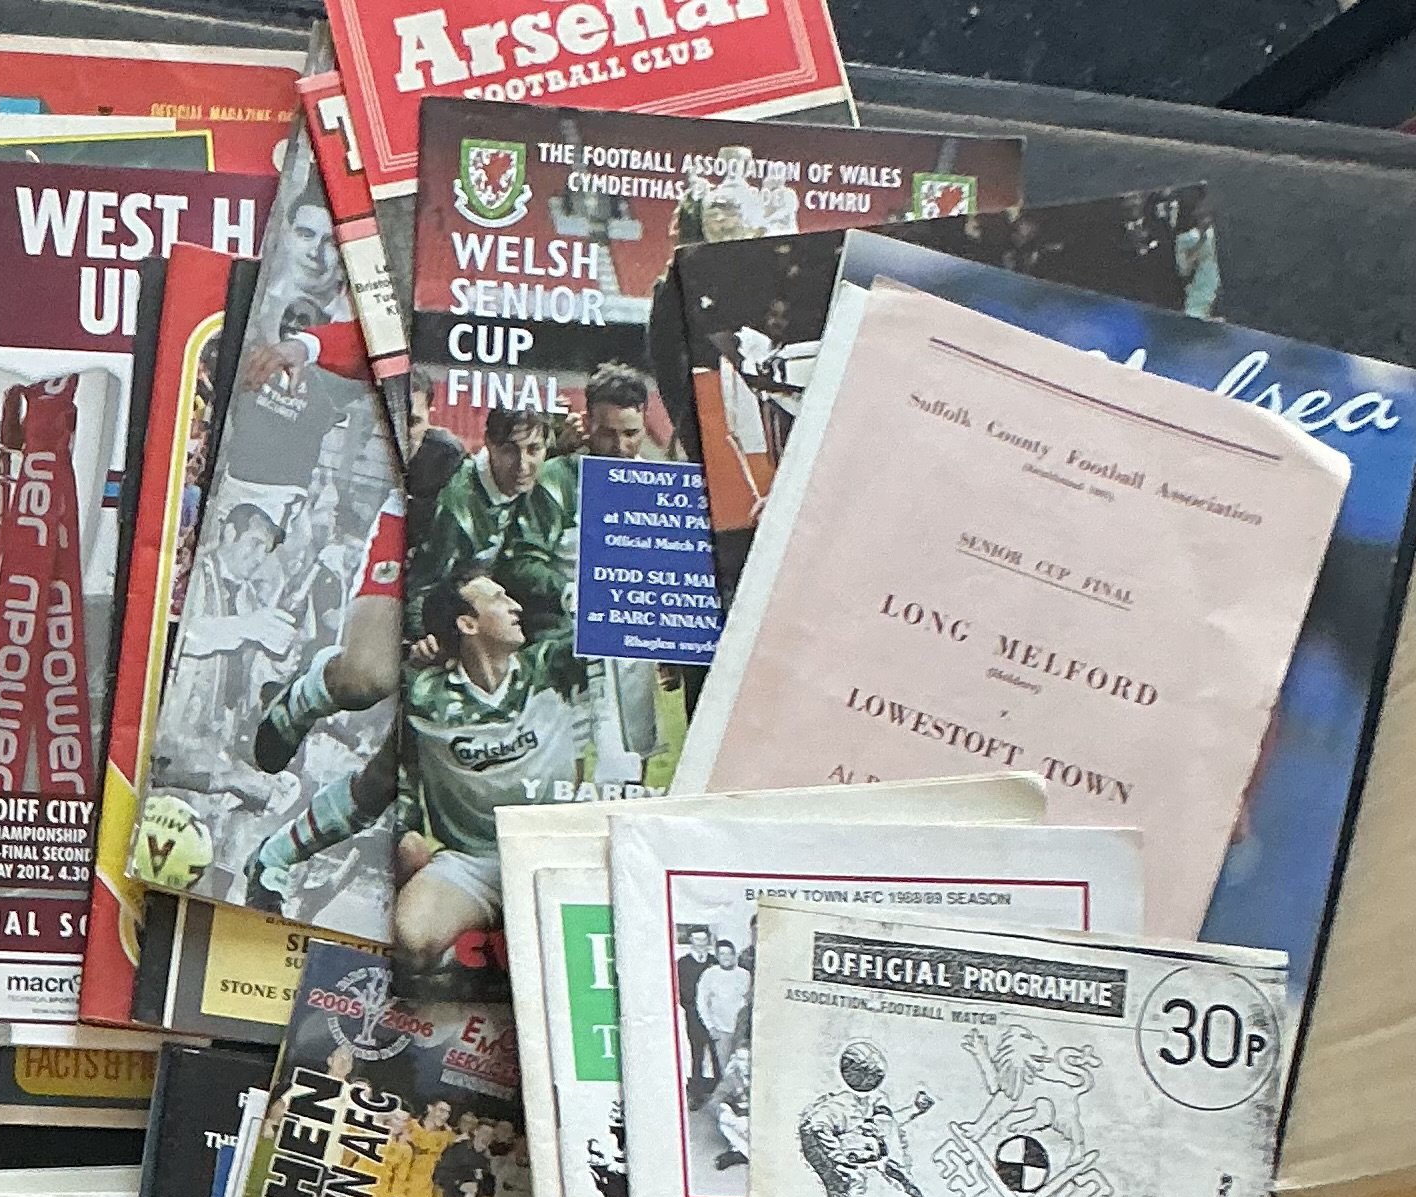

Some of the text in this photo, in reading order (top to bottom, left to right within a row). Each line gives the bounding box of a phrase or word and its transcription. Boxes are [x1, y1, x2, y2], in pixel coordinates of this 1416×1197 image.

[631, 37, 715, 74] CLUB
[150, 103, 273, 121] OFFICIAL MAGAZINE
[537, 143, 903, 189] THE FOOTBALL ASSOCIATION OF WALES
[567, 171, 685, 200] CYMDEITHAS
[804, 187, 872, 213] CYMRU
[16, 186, 189, 262] WEST
[452, 231, 599, 281] WELSH
[449, 277, 605, 327] SENIOR
[447, 323, 535, 364] CUP
[447, 367, 569, 415] FINAL
[608, 468, 677, 486] SUNDAY
[910, 393, 973, 428] Suffolk
[985, 419, 1052, 459] County
[1064, 449, 1145, 490] Football
[1155, 481, 1263, 527] Association
[656, 493, 693, 508] K.O.
[624, 511, 681, 529] NINIAN
[604, 534, 696, 552] Official Match
[593, 566, 680, 587] DYDD SUL
[959, 531, 1135, 605] SENIOR CUP FINAL
[627, 589, 657, 605] GIC
[608, 610, 655, 625] BARC
[879, 593, 974, 643] LONG
[993, 634, 1160, 708] MELFORD
[450, 726, 539, 767] Carlsberg
[846, 686, 1136, 806] LOWESTOFT TOWN
[46, 800, 95, 825] CITY
[42, 847, 93, 862] SECOND
[17, 865, 55, 882] 2012,
[58, 866, 90, 882] 4.30
[803, 888, 1012, 906] TOWN AFC SEASON
[220, 978, 277, 999] STONE
[821, 948, 1113, 1008] OFFICIAL PROGRAMME
[307, 988, 365, 1020] 2005
[786, 987, 945, 1022] ASSOCIATION FOOTBALL
